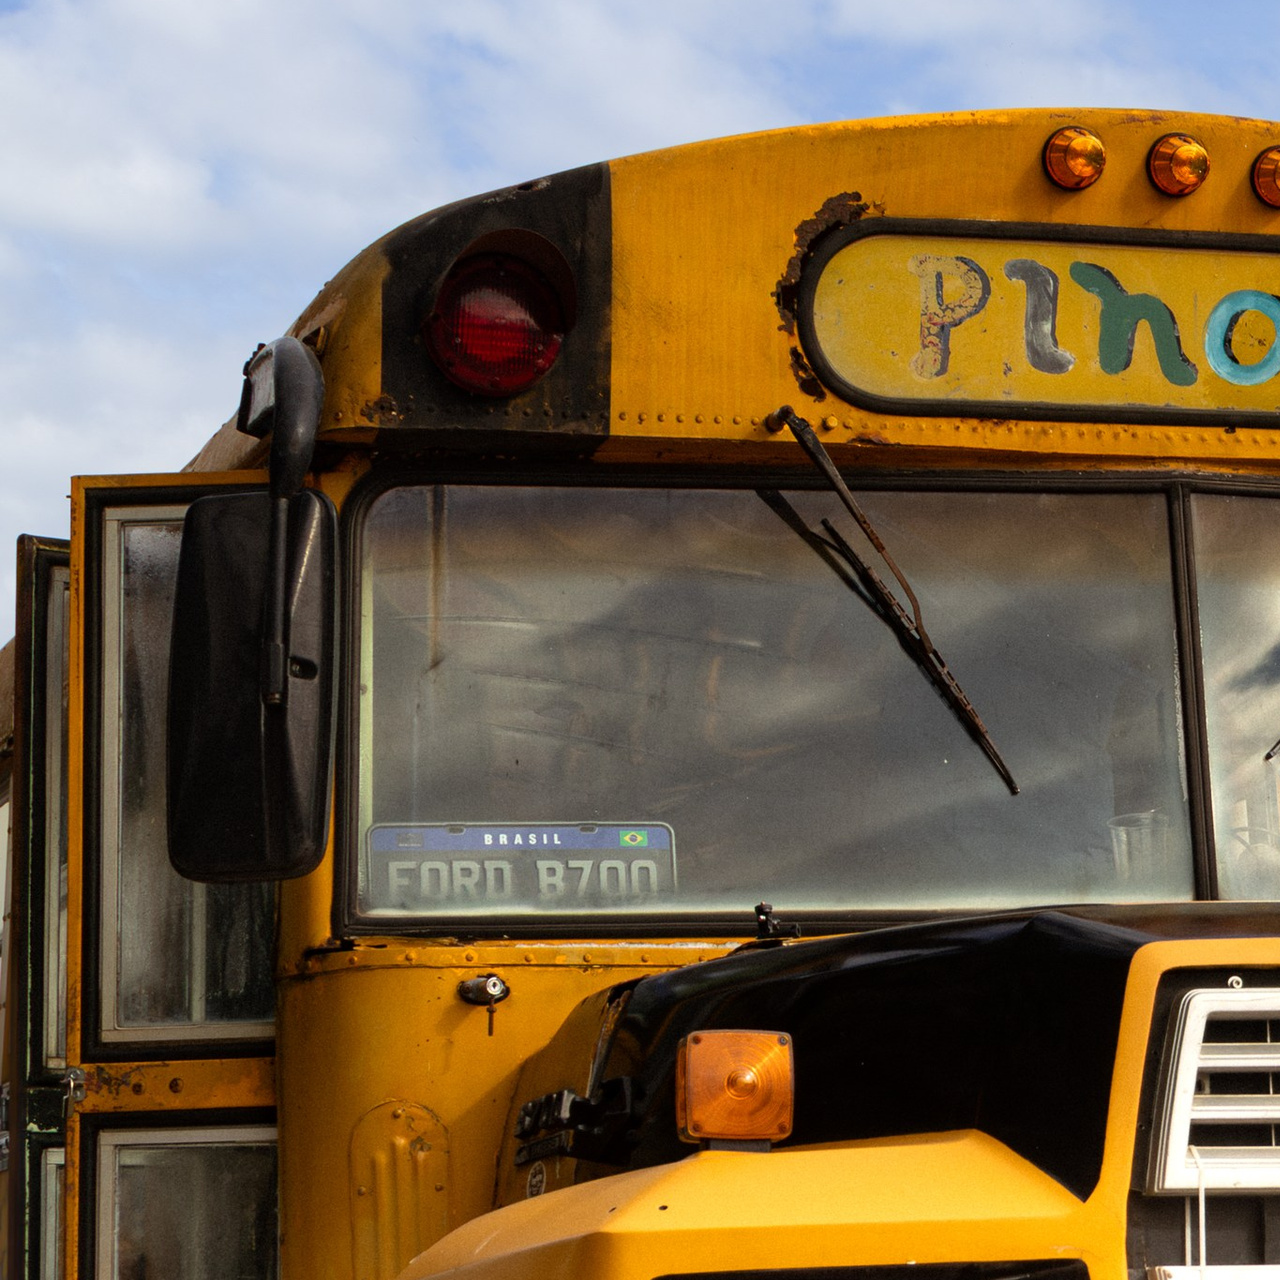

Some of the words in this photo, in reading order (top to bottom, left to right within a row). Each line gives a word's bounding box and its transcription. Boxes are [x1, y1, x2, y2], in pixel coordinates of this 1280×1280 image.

[483, 833, 562, 845] BRASIL
[387, 860, 514, 904] FORD
[535, 859, 658, 902] B700
